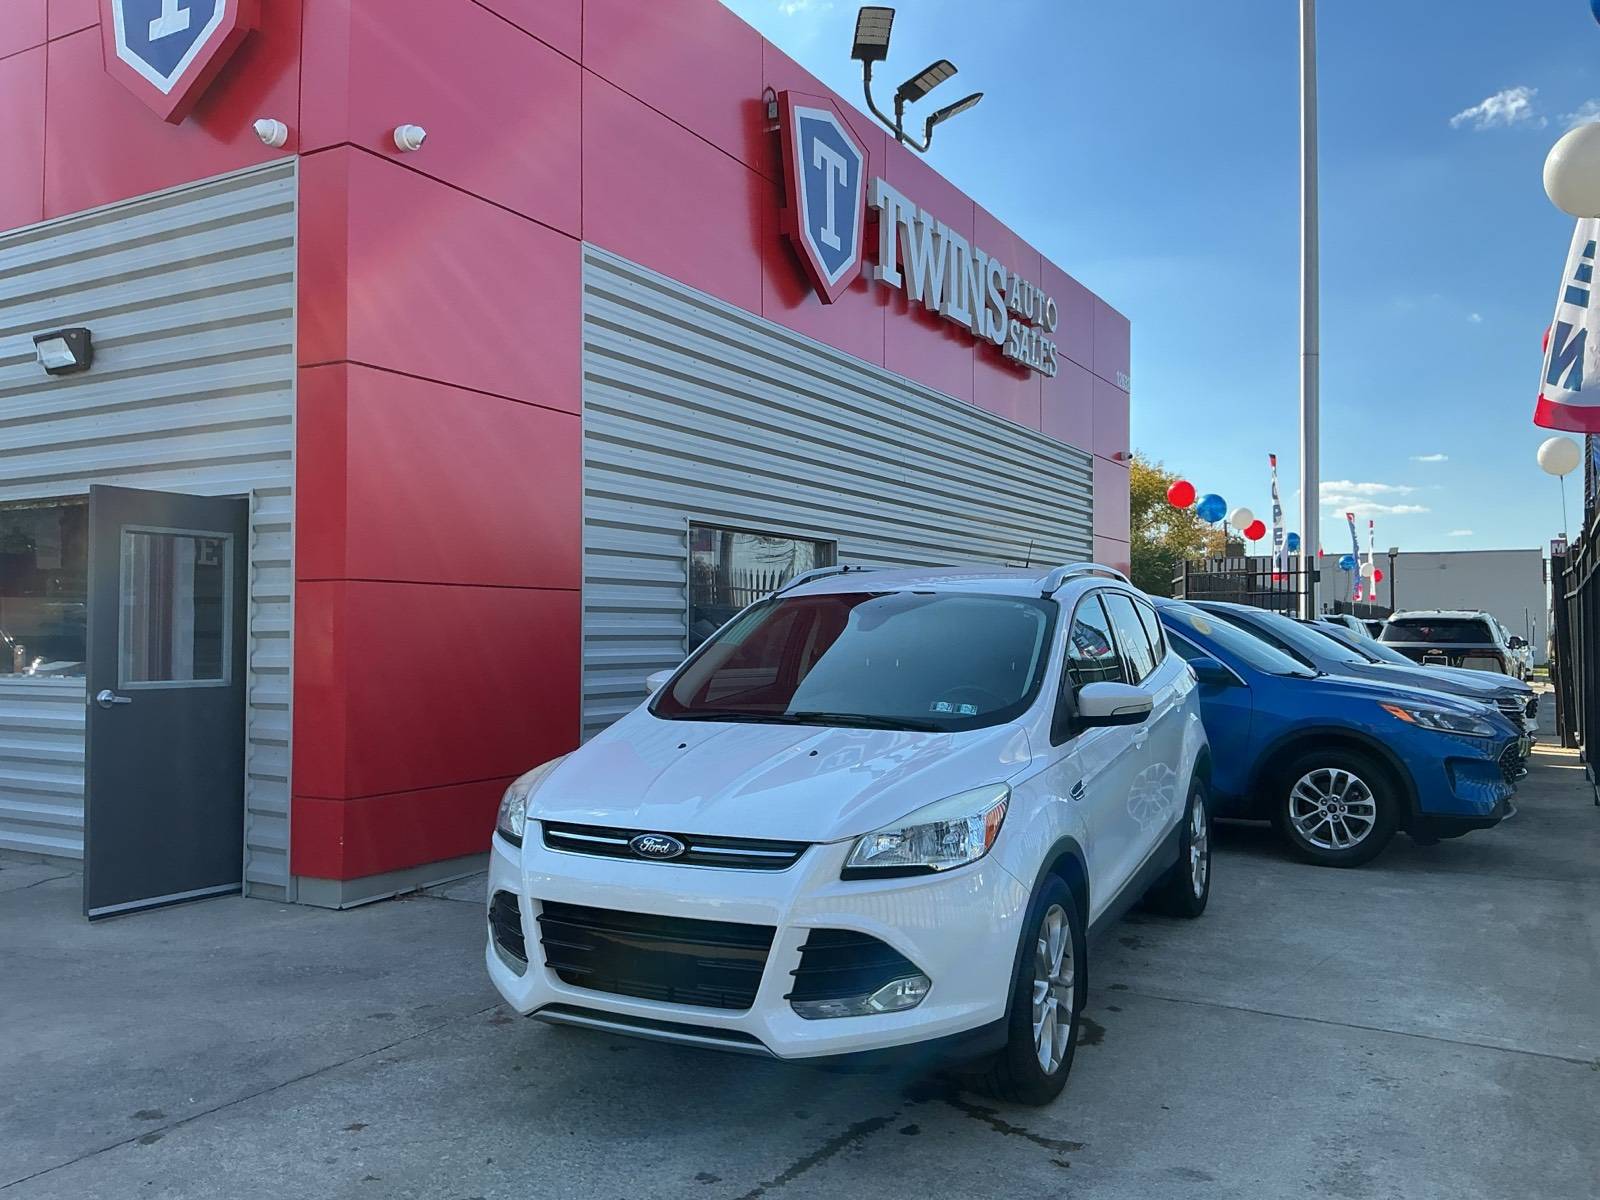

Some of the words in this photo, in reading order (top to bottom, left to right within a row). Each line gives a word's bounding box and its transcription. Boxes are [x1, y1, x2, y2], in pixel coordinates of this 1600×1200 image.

[814, 136, 847, 251] T
[870, 176, 1008, 345] TWINS
[1010, 272, 1057, 333] AUTO
[1007, 319, 1057, 378] SALES
[640, 837, 670, 854] Ford
